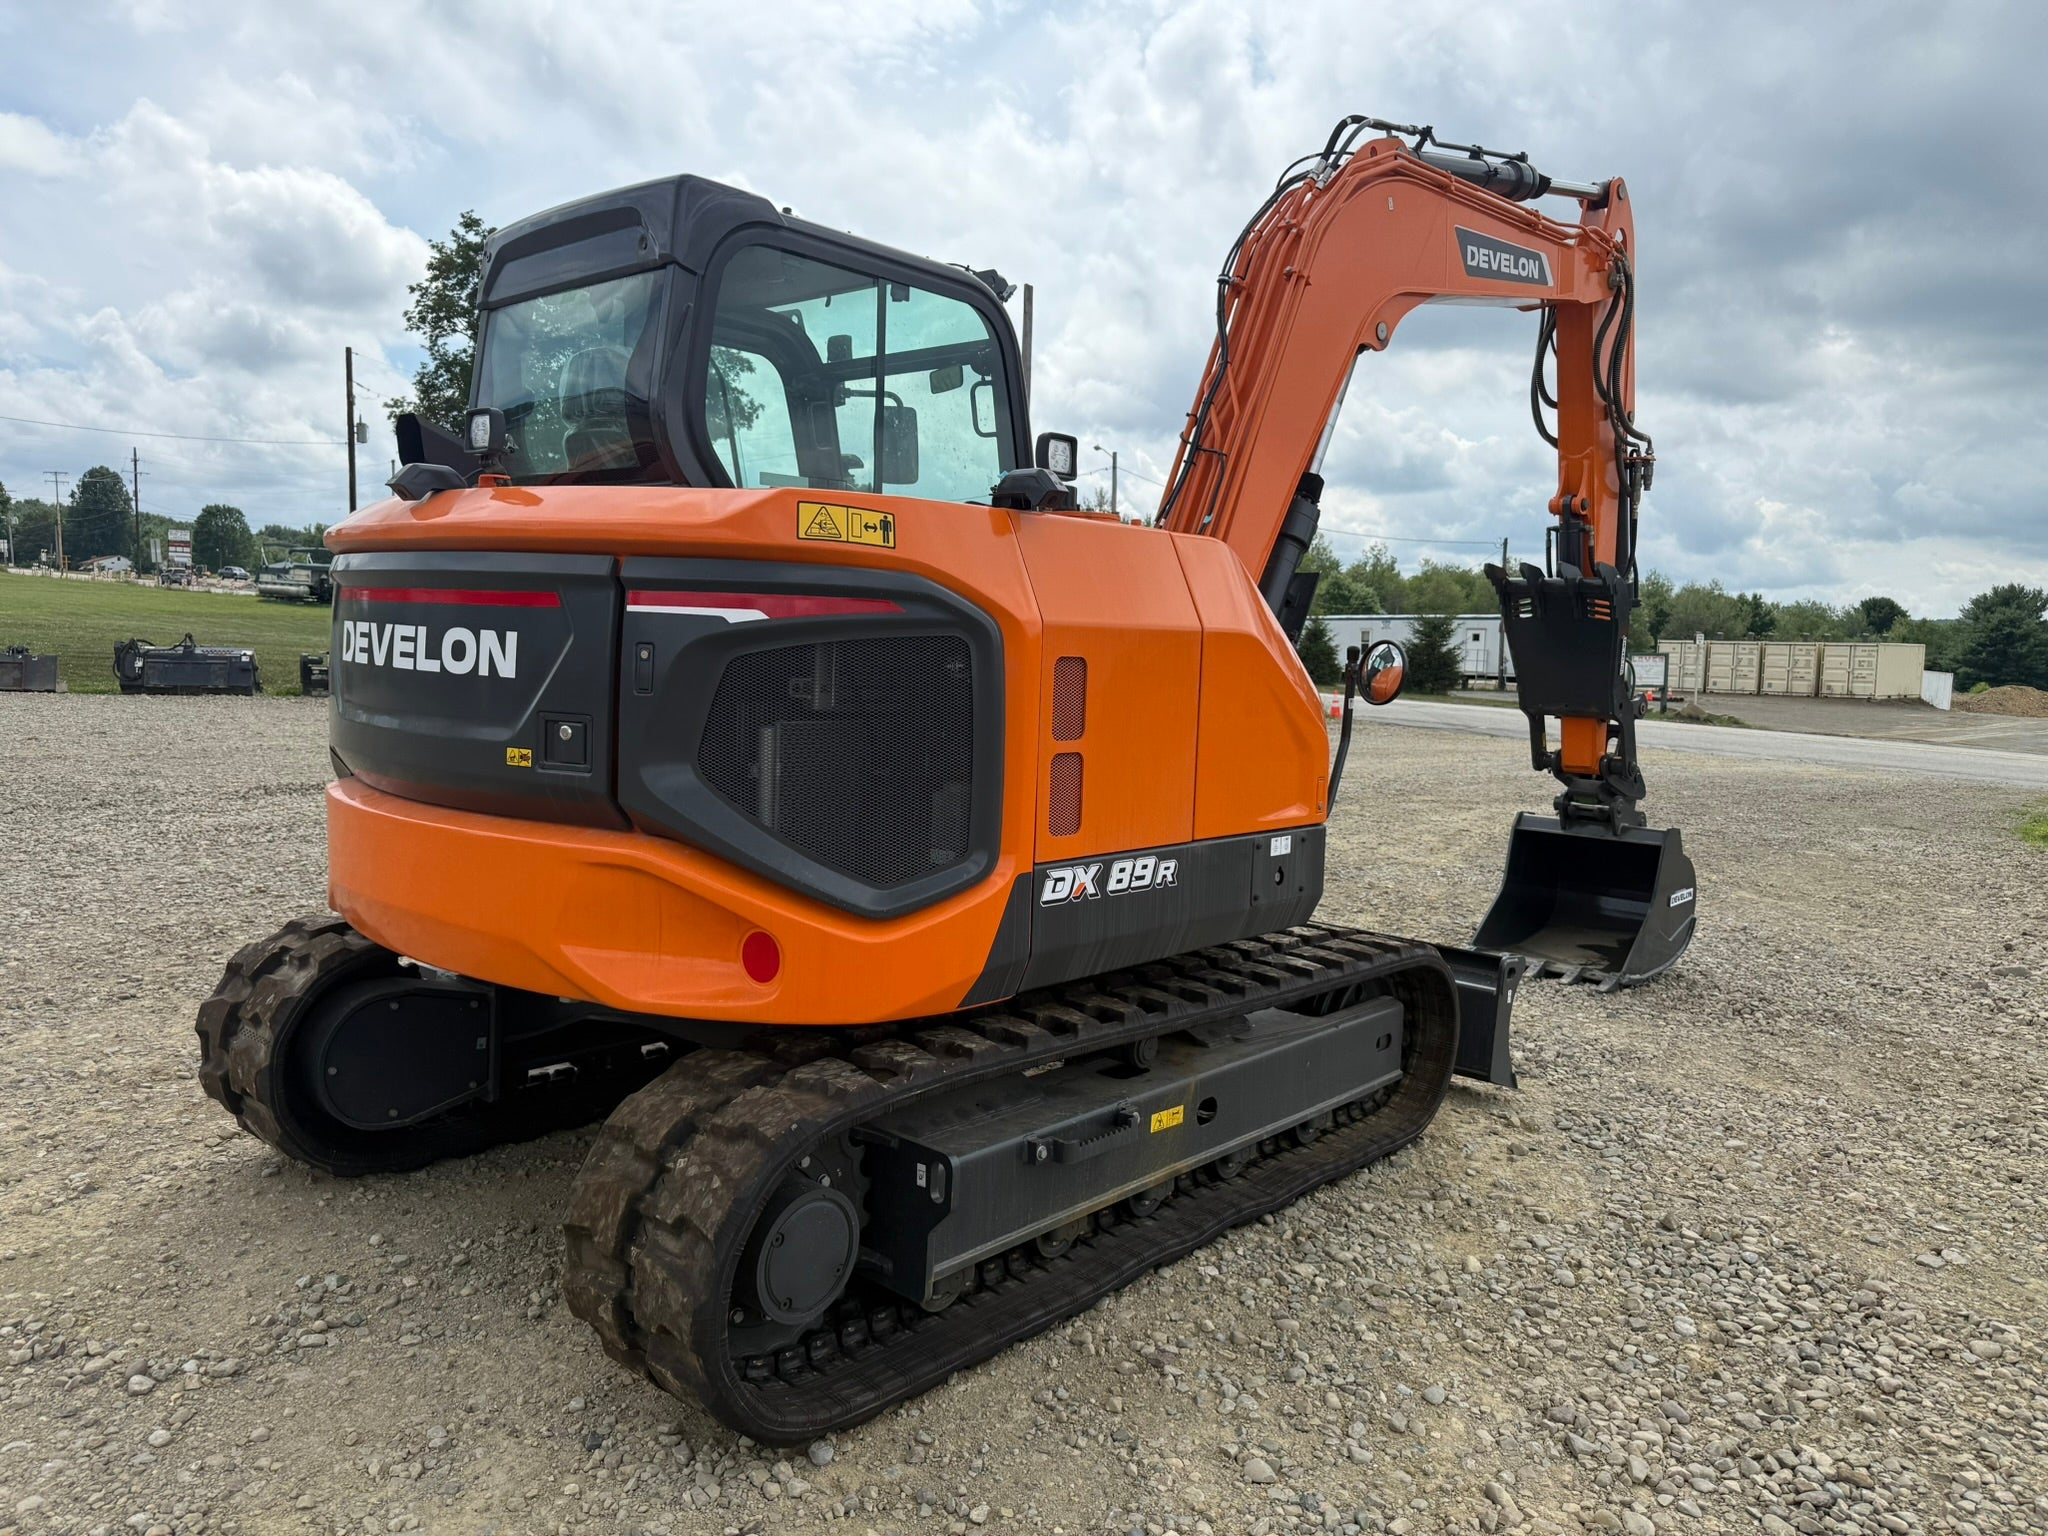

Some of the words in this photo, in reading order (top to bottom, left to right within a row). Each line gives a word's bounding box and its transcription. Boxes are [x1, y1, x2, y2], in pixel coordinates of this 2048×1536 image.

[1466, 245, 1539, 280] DEVELON
[342, 621, 518, 679] DEVELON
[1040, 863, 1103, 907] DX
